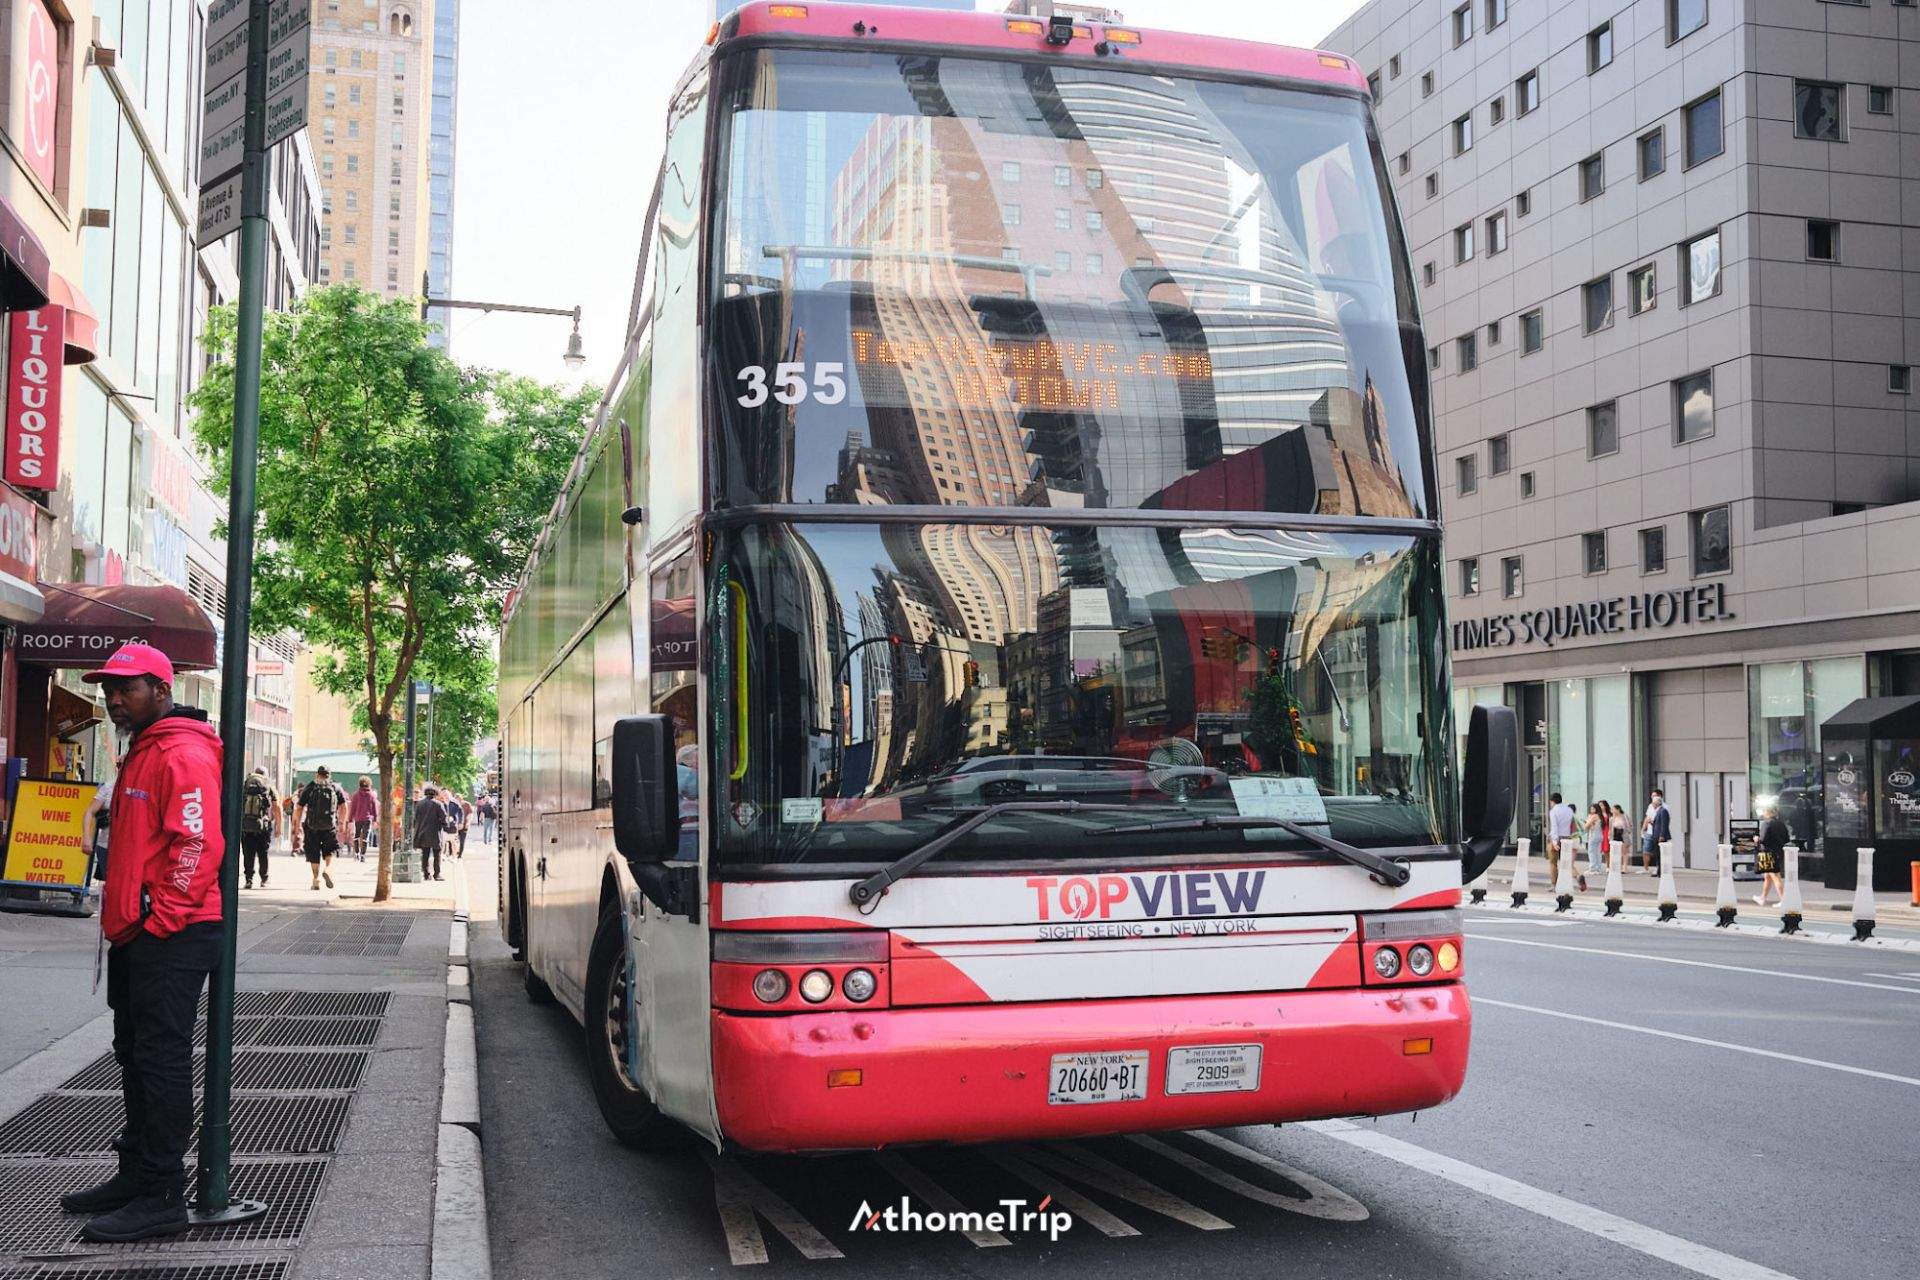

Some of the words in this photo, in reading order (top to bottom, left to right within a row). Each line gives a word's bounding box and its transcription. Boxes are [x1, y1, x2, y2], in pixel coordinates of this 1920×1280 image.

[205, 190, 227, 211] Avenue
[737, 362, 846, 408] 355
[955, 374, 1118, 408] UPTOWN
[18, 310, 49, 478] LIQUORS
[1451, 615, 1516, 651] TIMES
[1519, 597, 1626, 647] SQUARE
[1627, 582, 1736, 630] HOTEL
[22, 634, 74, 649] ROOF
[78, 635, 116, 649] TOP
[38, 785, 80, 799] LIQUOR
[41, 809, 71, 823] WINE
[15, 831, 82, 848] CHAMPAGN
[32, 857, 63, 870] COLD
[25, 871, 65, 885] WATER
[1026, 871, 1266, 921] TOPVIEW
[1038, 924, 1144, 940] SIGHTSEEING
[1170, 921, 1207, 935] NEW
[1213, 919, 1257, 933] YORK
[1076, 1056, 1098, 1066] NEW
[1100, 1054, 1125, 1064] YORK
[1197, 1065, 1229, 1080] 2909
